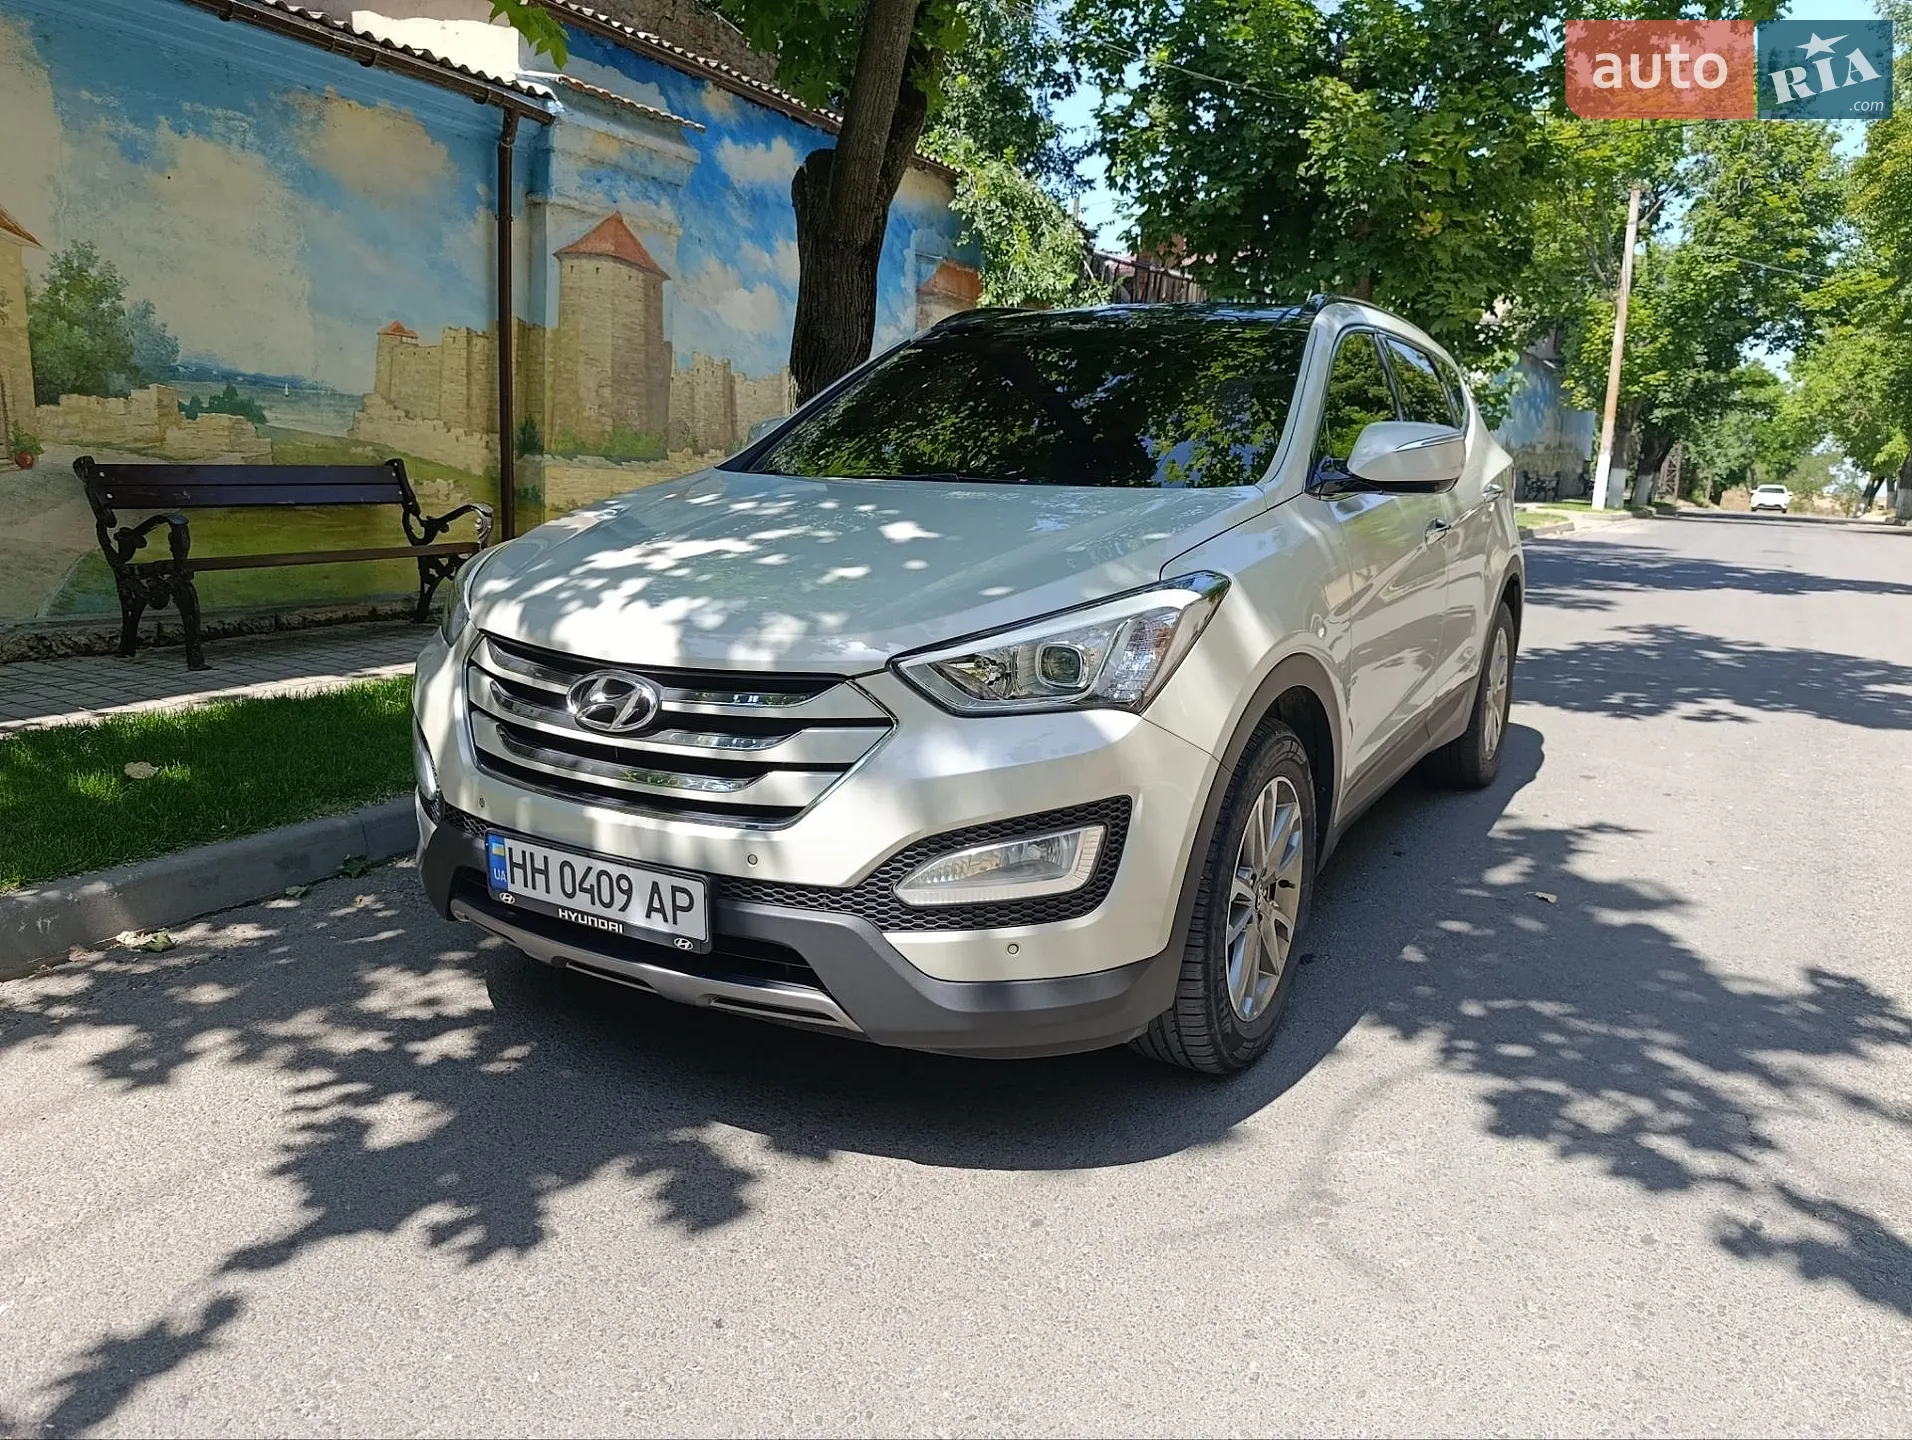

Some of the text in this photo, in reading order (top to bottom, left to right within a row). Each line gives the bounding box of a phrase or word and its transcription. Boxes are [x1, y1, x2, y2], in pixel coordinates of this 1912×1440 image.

[493, 867, 507, 883] UA
[508, 846, 695, 926] HH 0409 AP
[558, 908, 624, 934] HYUNDAI
